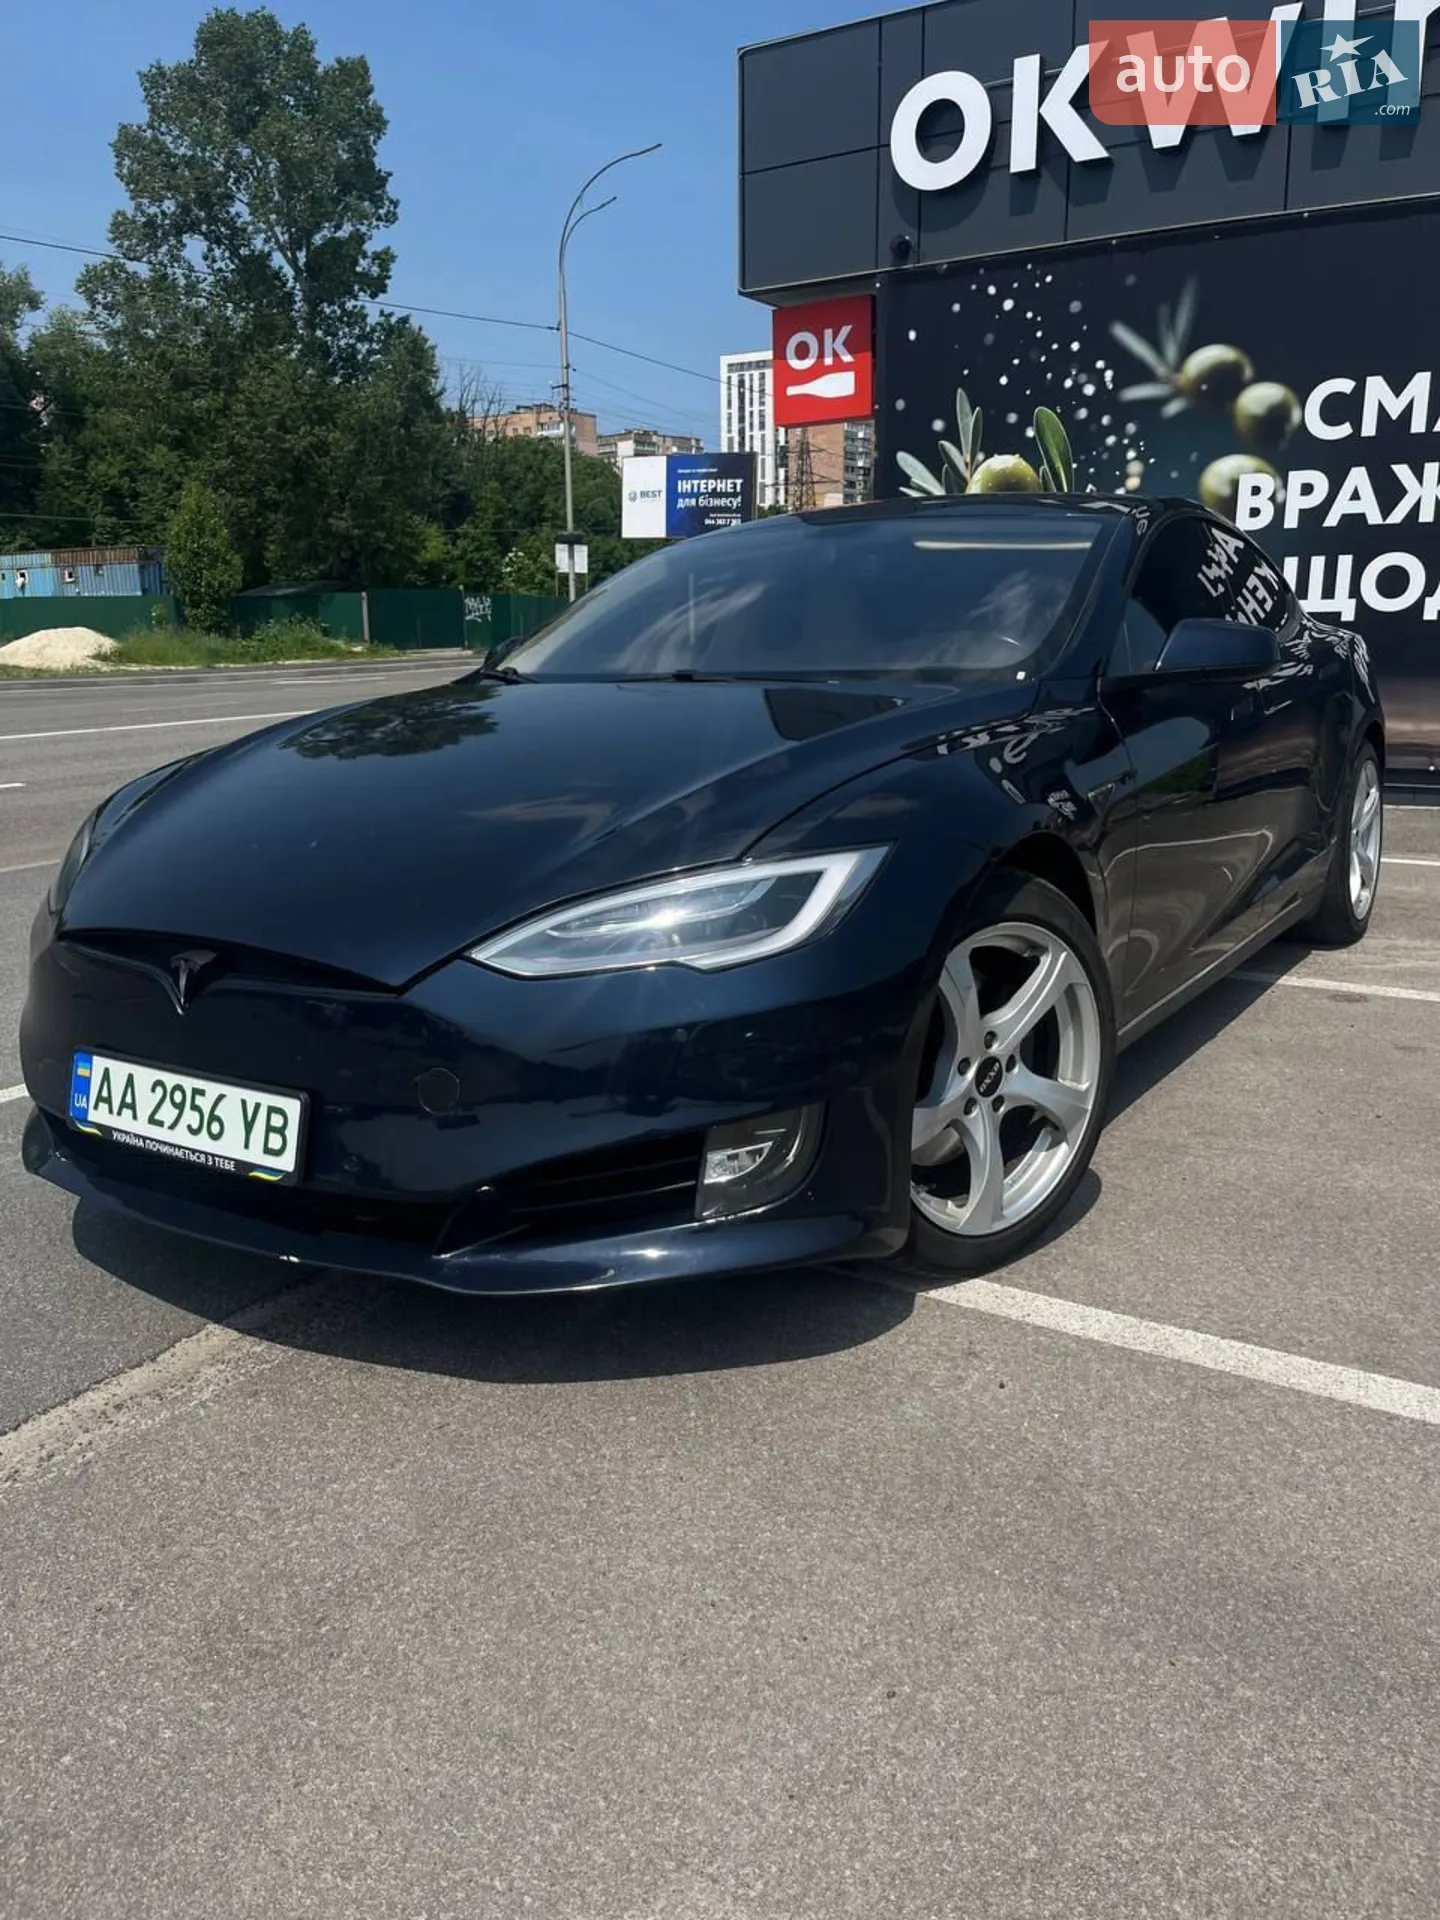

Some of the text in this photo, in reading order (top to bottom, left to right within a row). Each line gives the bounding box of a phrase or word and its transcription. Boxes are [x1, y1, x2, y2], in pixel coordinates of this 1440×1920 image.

[786, 325, 855, 370] OK
[1304, 371, 1440, 440] СМ
[640, 489, 663, 498] BEST
[676, 494, 742, 510] для бізнесу!
[677, 478, 744, 493] ІНТЕРНЕТ
[1283, 551, 1440, 622] ЩО
[75, 1093, 88, 1110] UA
[93, 1067, 289, 1157] AA 2956 YB
[112, 1130, 145, 1148] УКРАЇНА
[214, 1158, 237, 1171] ТЕБЕ
